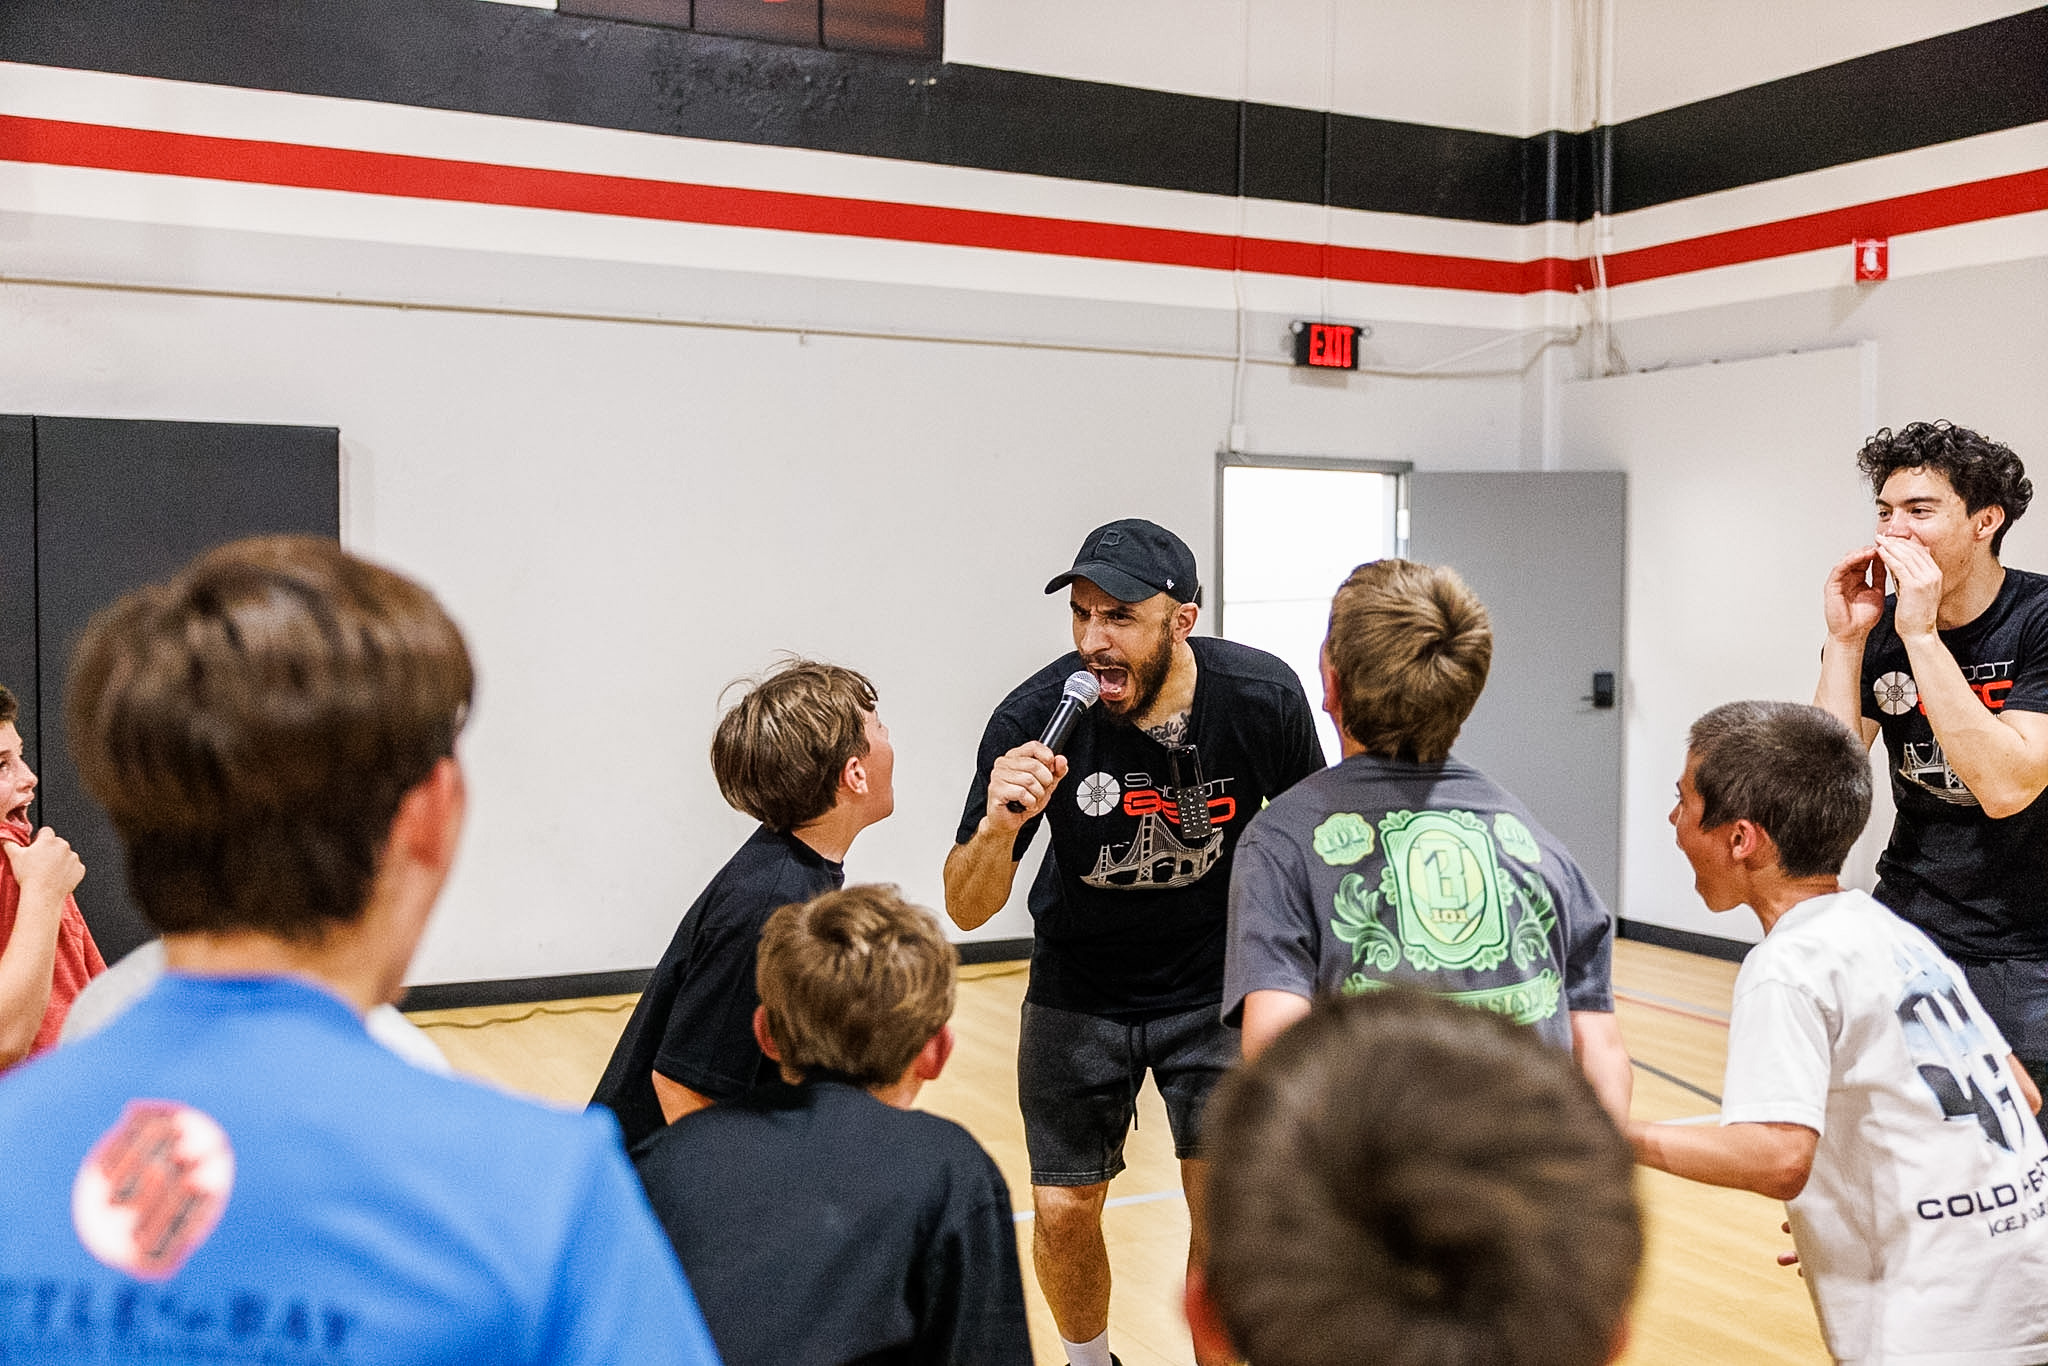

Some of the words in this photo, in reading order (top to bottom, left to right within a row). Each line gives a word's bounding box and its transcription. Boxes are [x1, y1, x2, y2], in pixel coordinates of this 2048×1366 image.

[1309, 324, 1354, 368] EXIT
[1961, 659, 2014, 681] OOT
[1431, 908, 1469, 924] 101
[1917, 1184, 2018, 1220] COLD
